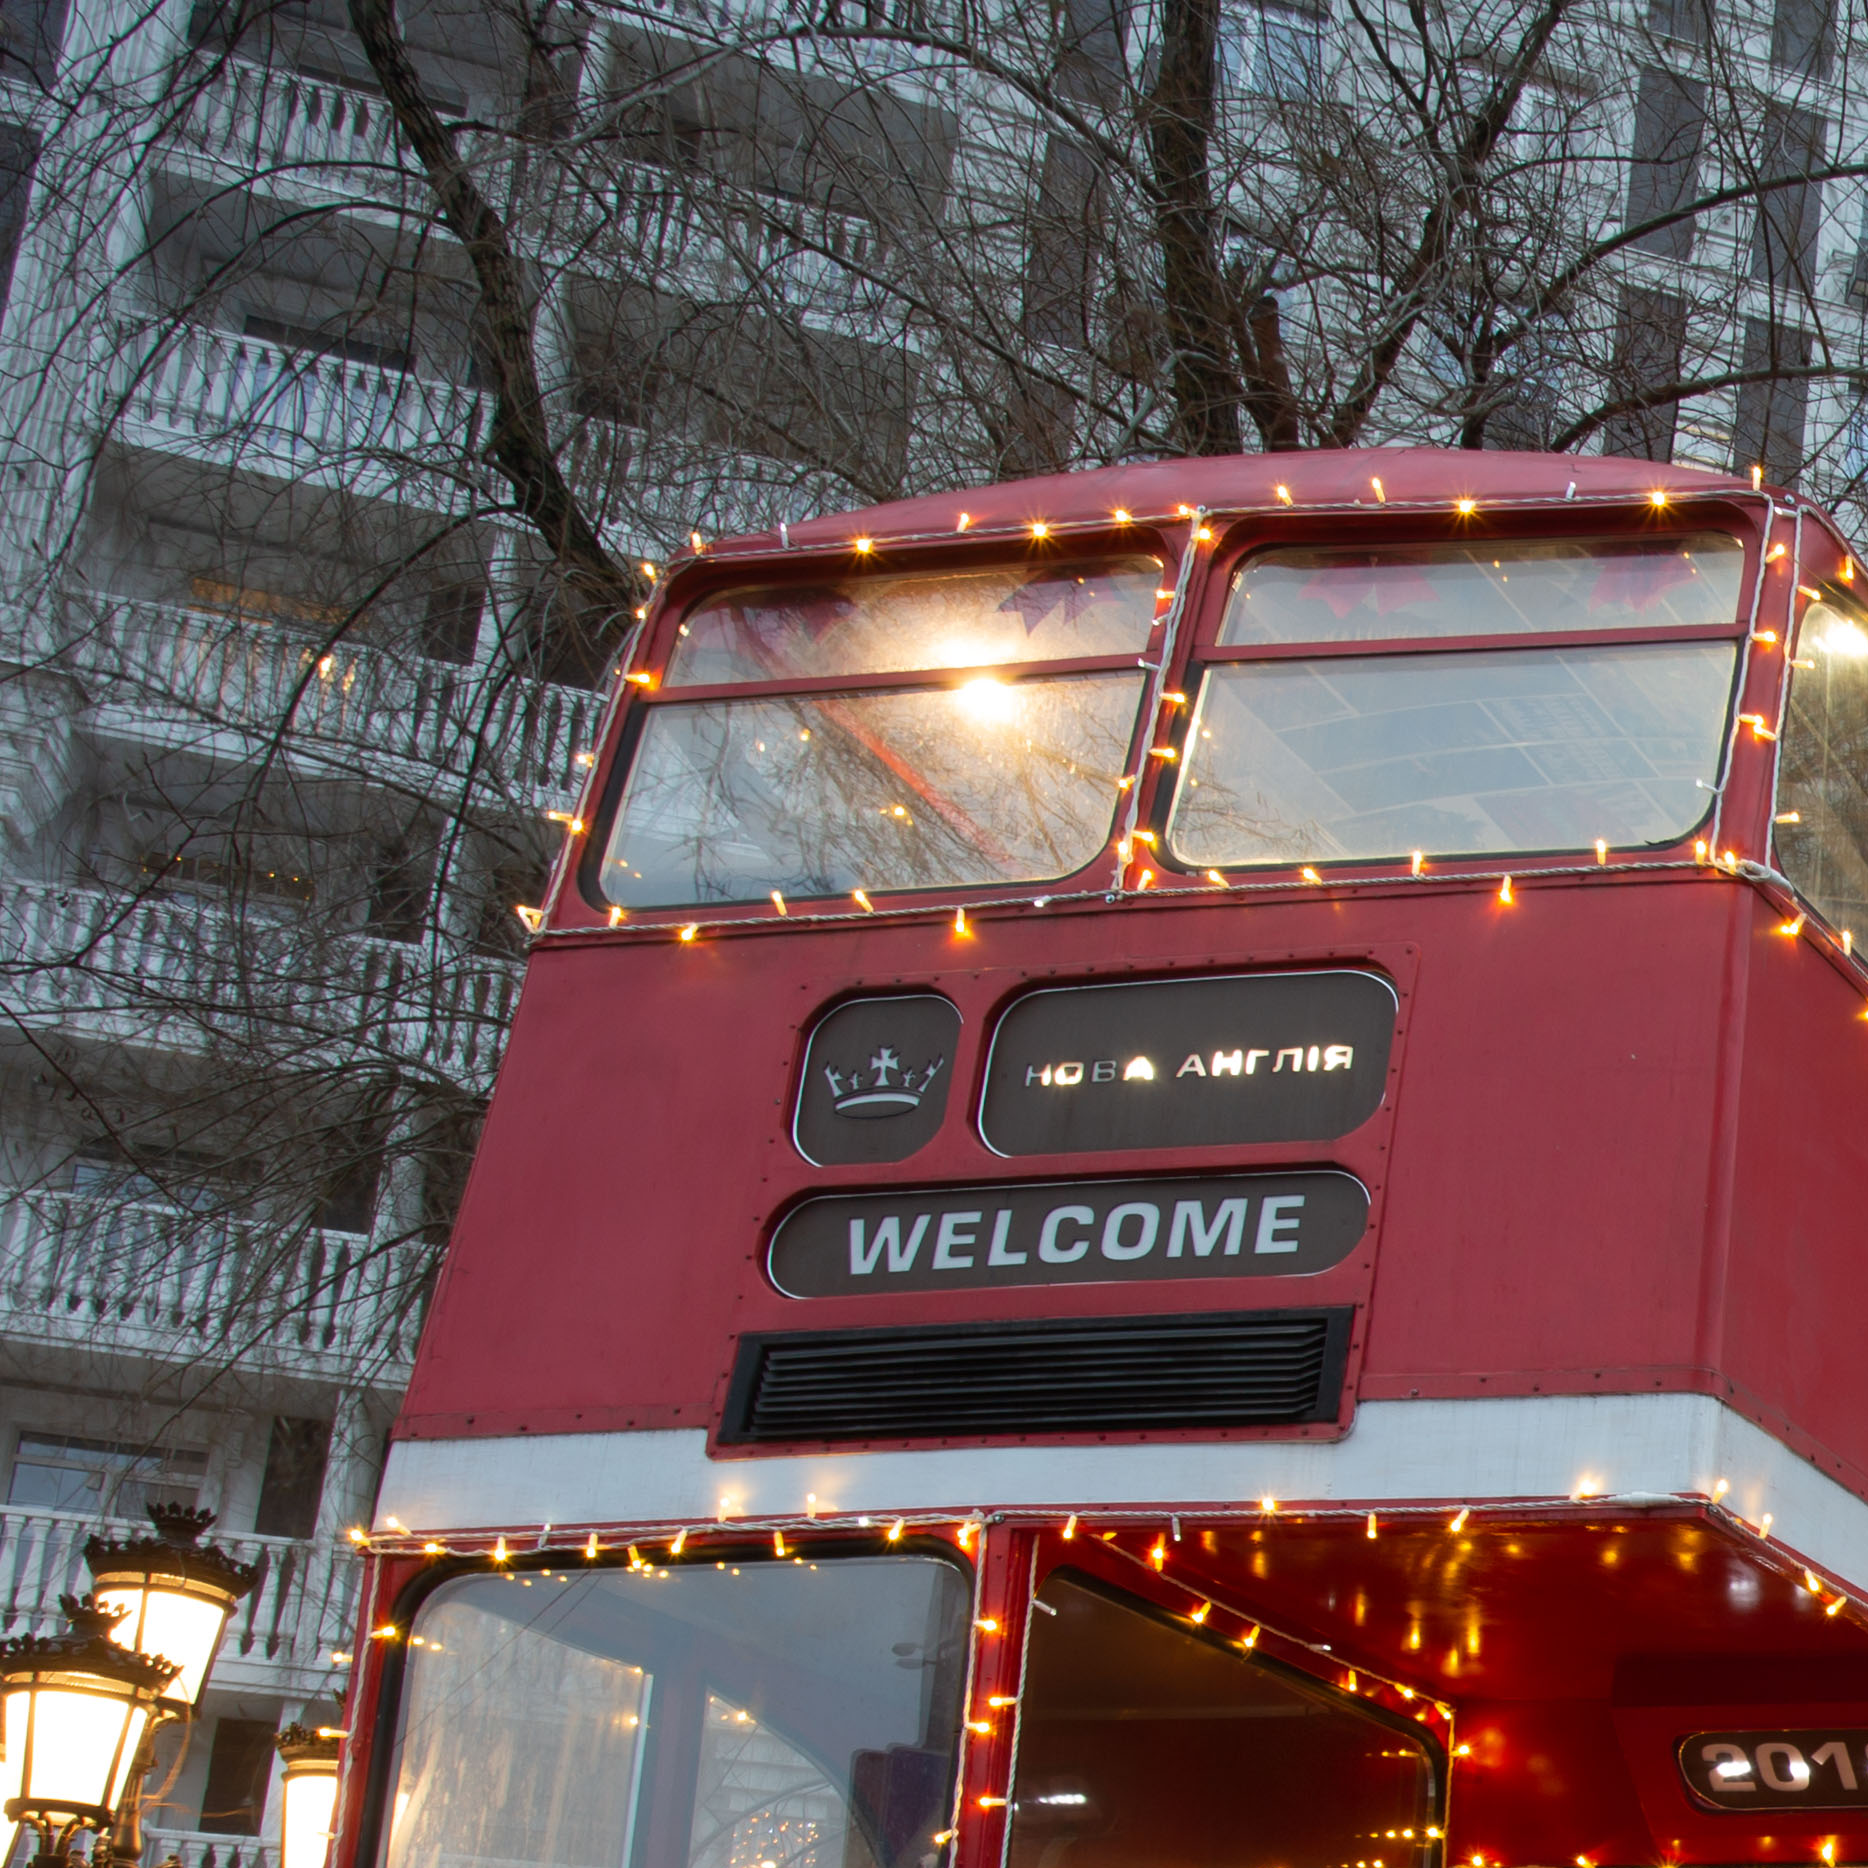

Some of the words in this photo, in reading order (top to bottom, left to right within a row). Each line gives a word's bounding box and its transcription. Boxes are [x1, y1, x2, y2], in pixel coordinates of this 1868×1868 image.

[1024, 1055, 1155, 1088] НОВА
[1176, 1044, 1355, 1080] АНГЛІЯ
[847, 1194, 1306, 1276] WELCOME
